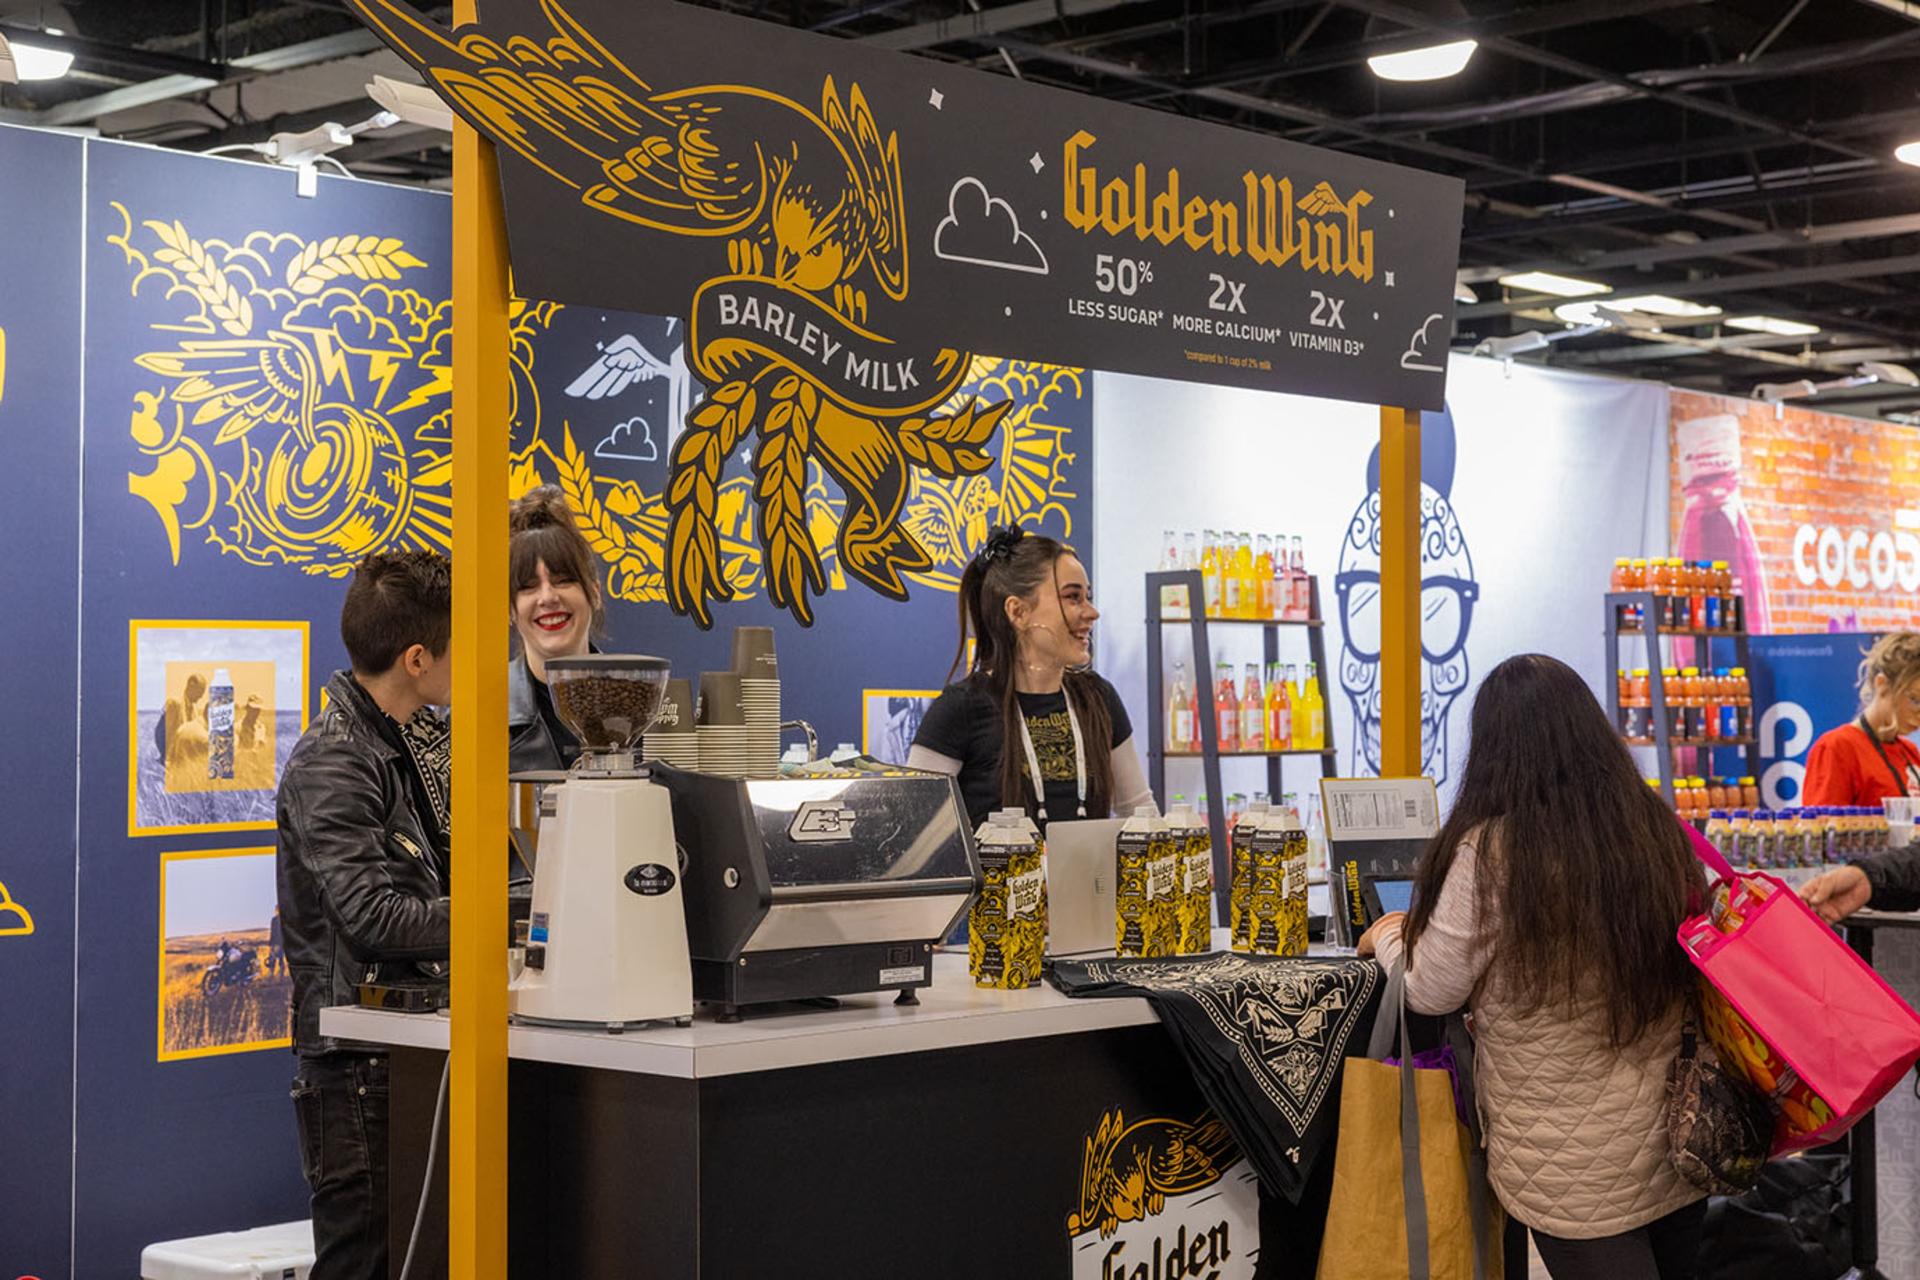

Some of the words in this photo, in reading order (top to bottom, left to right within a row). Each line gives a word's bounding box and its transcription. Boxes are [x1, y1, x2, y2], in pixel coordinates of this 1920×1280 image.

[1095, 254, 1154, 296] 50%
[1208, 272, 1247, 314] 2X
[1068, 298, 1105, 318] LESS
[1172, 314, 1212, 334] MORE
[1310, 290, 1345, 330] 2X
[718, 293, 842, 366] BARLEY
[844, 351, 919, 392] MILK
[1289, 331, 1341, 353] VITAMIN
